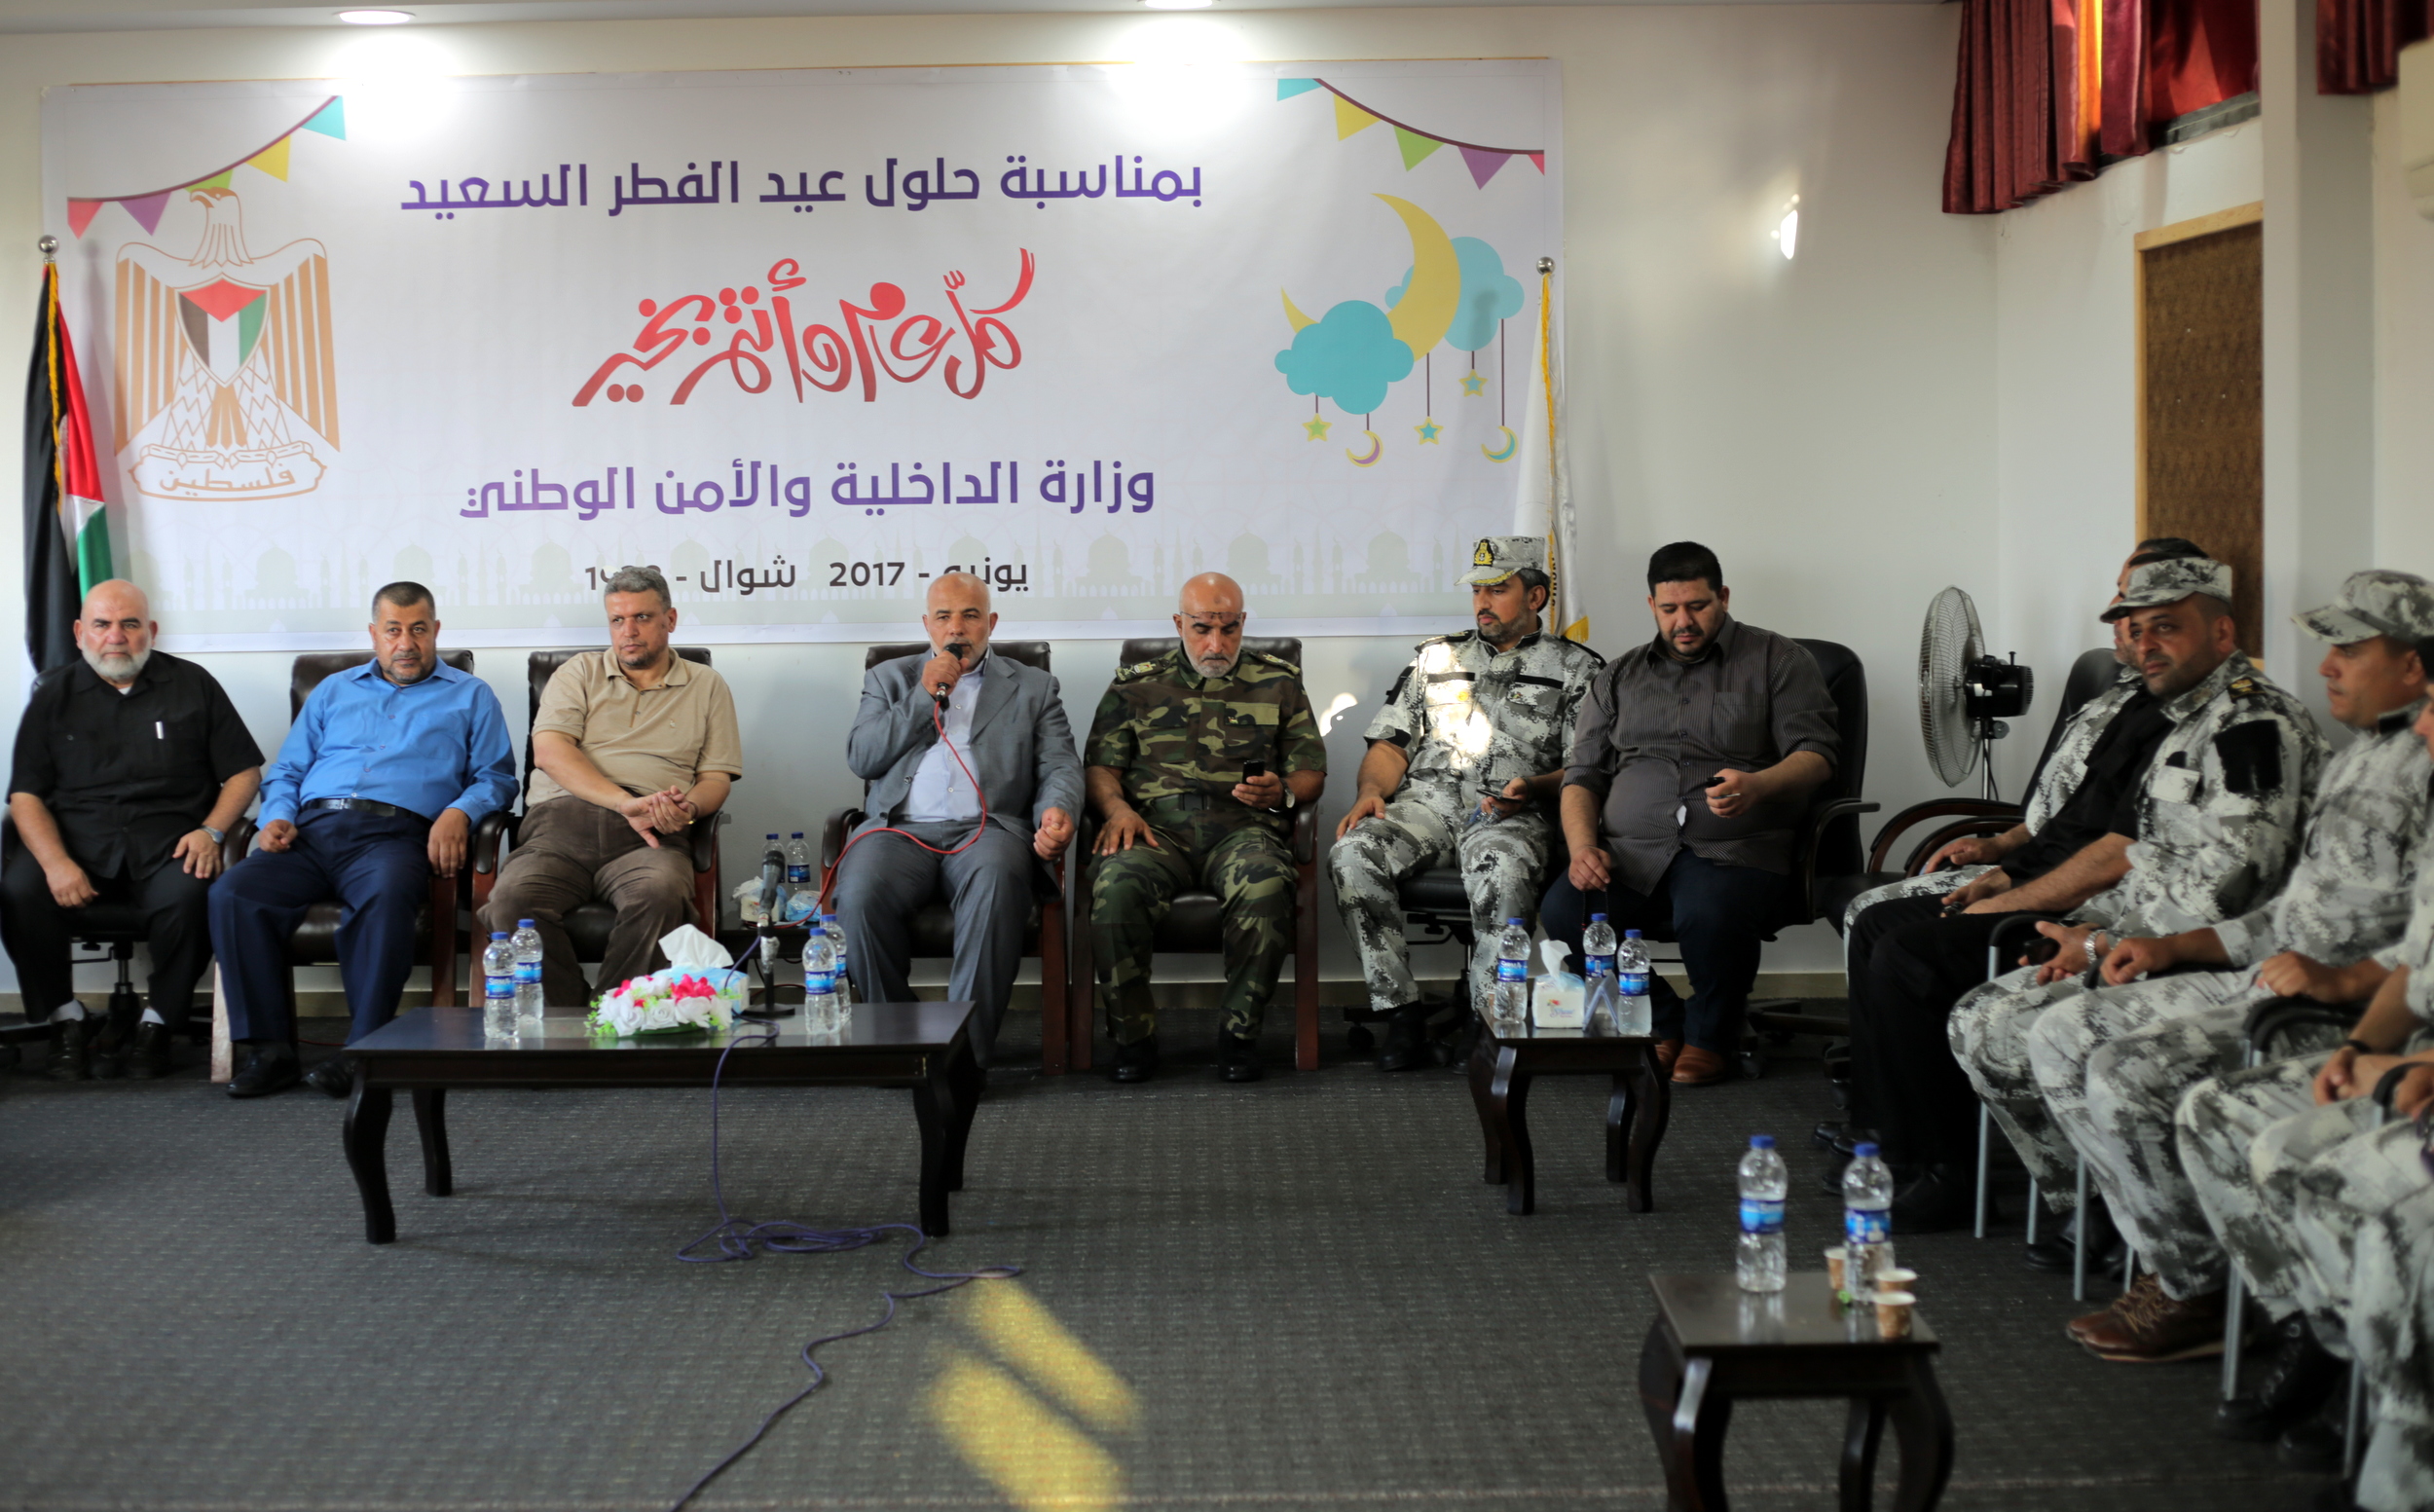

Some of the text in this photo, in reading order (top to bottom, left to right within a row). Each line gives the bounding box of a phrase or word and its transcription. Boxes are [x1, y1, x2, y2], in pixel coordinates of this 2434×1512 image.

[400, 156, 1202, 221] بمناسبة حلول عيد الفطر السعيد
[572, 294, 717, 407] بخير
[839, 281, 956, 403] عام
[160, 462, 296, 498] فلسطين
[459, 458, 1155, 522] وزارة الداخلية والأمن الوطني
[701, 554, 795, 596] شوال
[830, 562, 905, 586] 2017
